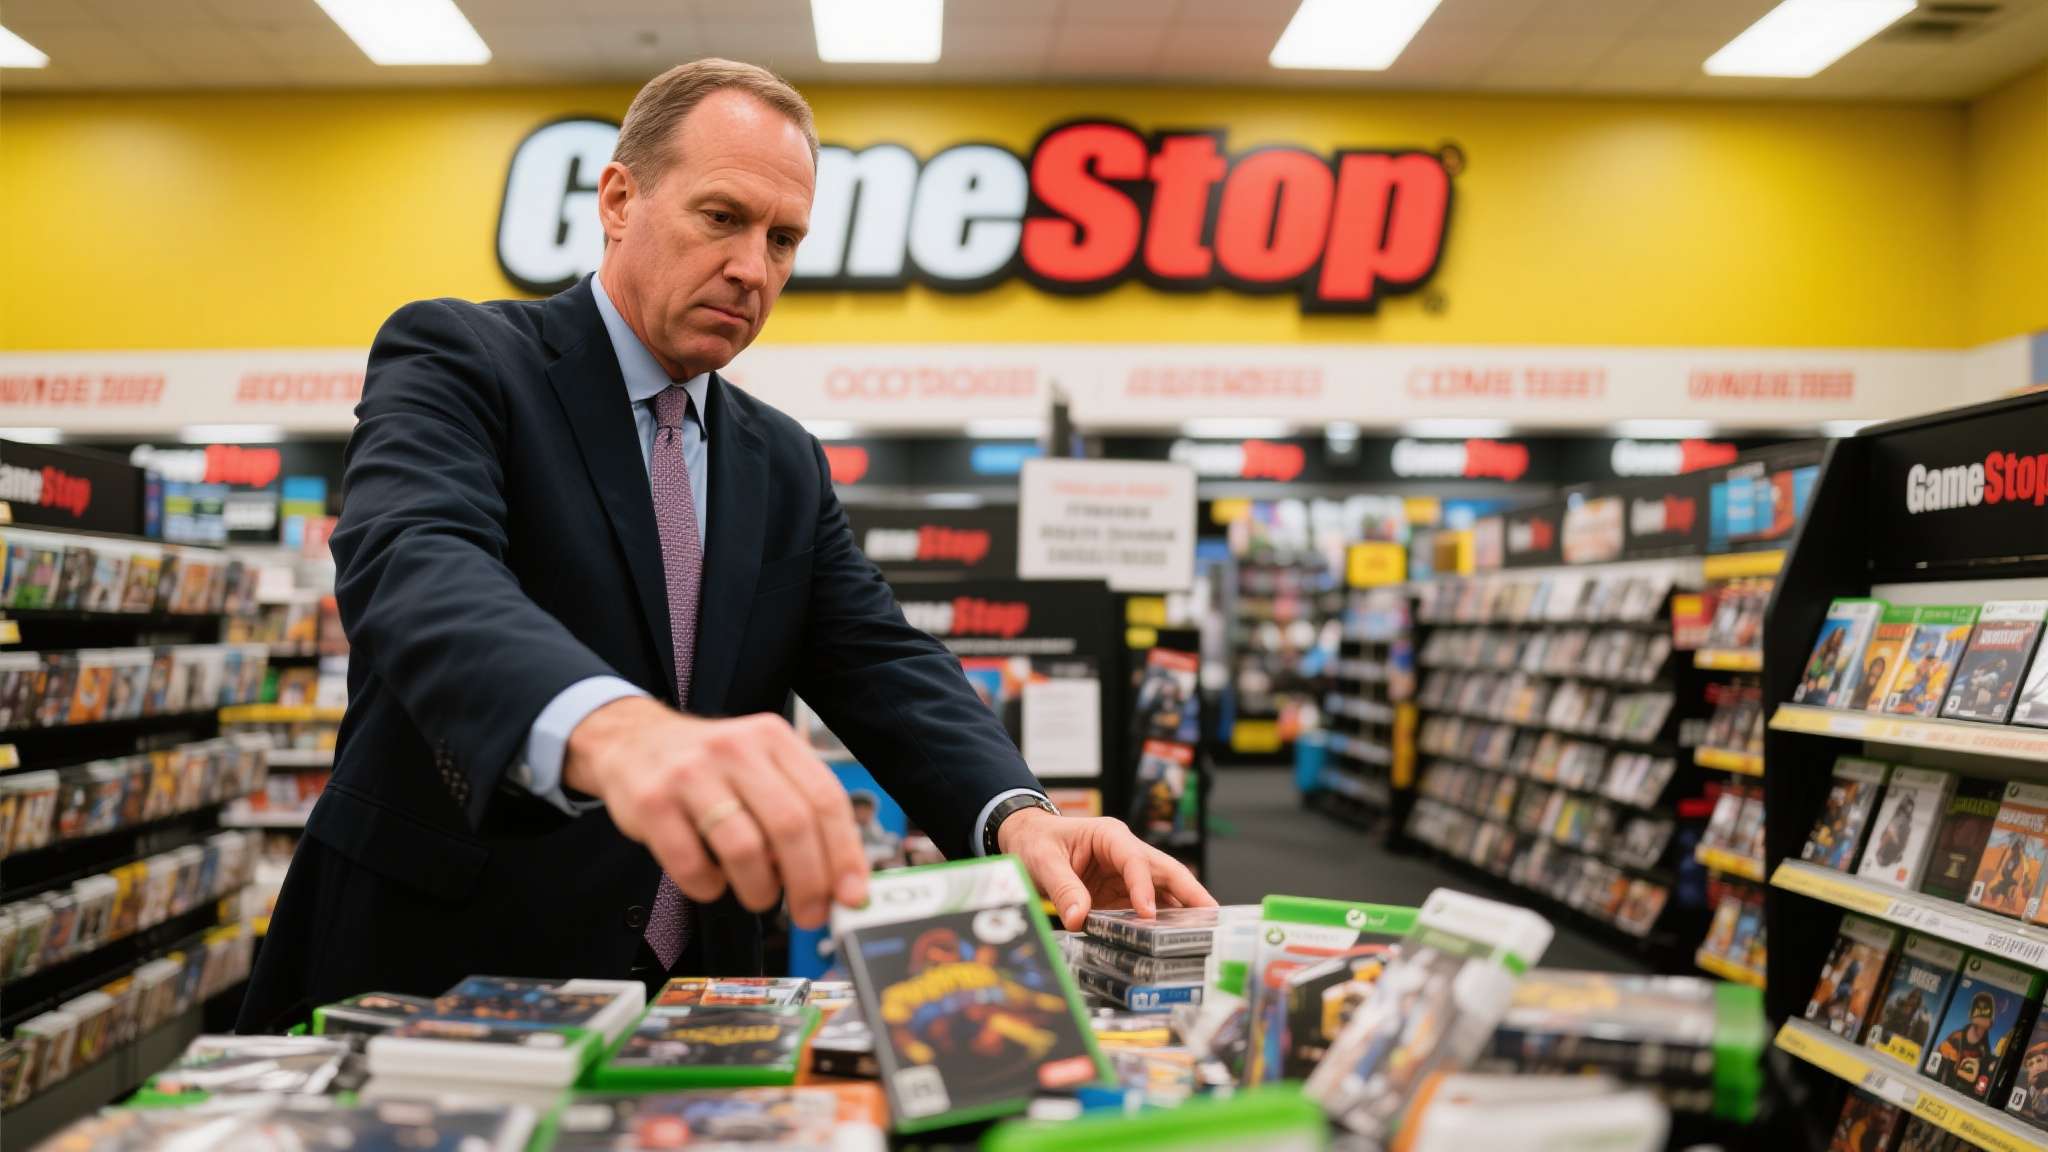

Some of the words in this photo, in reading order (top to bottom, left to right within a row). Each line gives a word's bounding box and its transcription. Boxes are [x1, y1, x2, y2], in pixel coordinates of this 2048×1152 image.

[496, 119, 1453, 313] GmeStop
[0, 463, 91, 518] ameStop
[1906, 450, 2048, 515] GameStop
